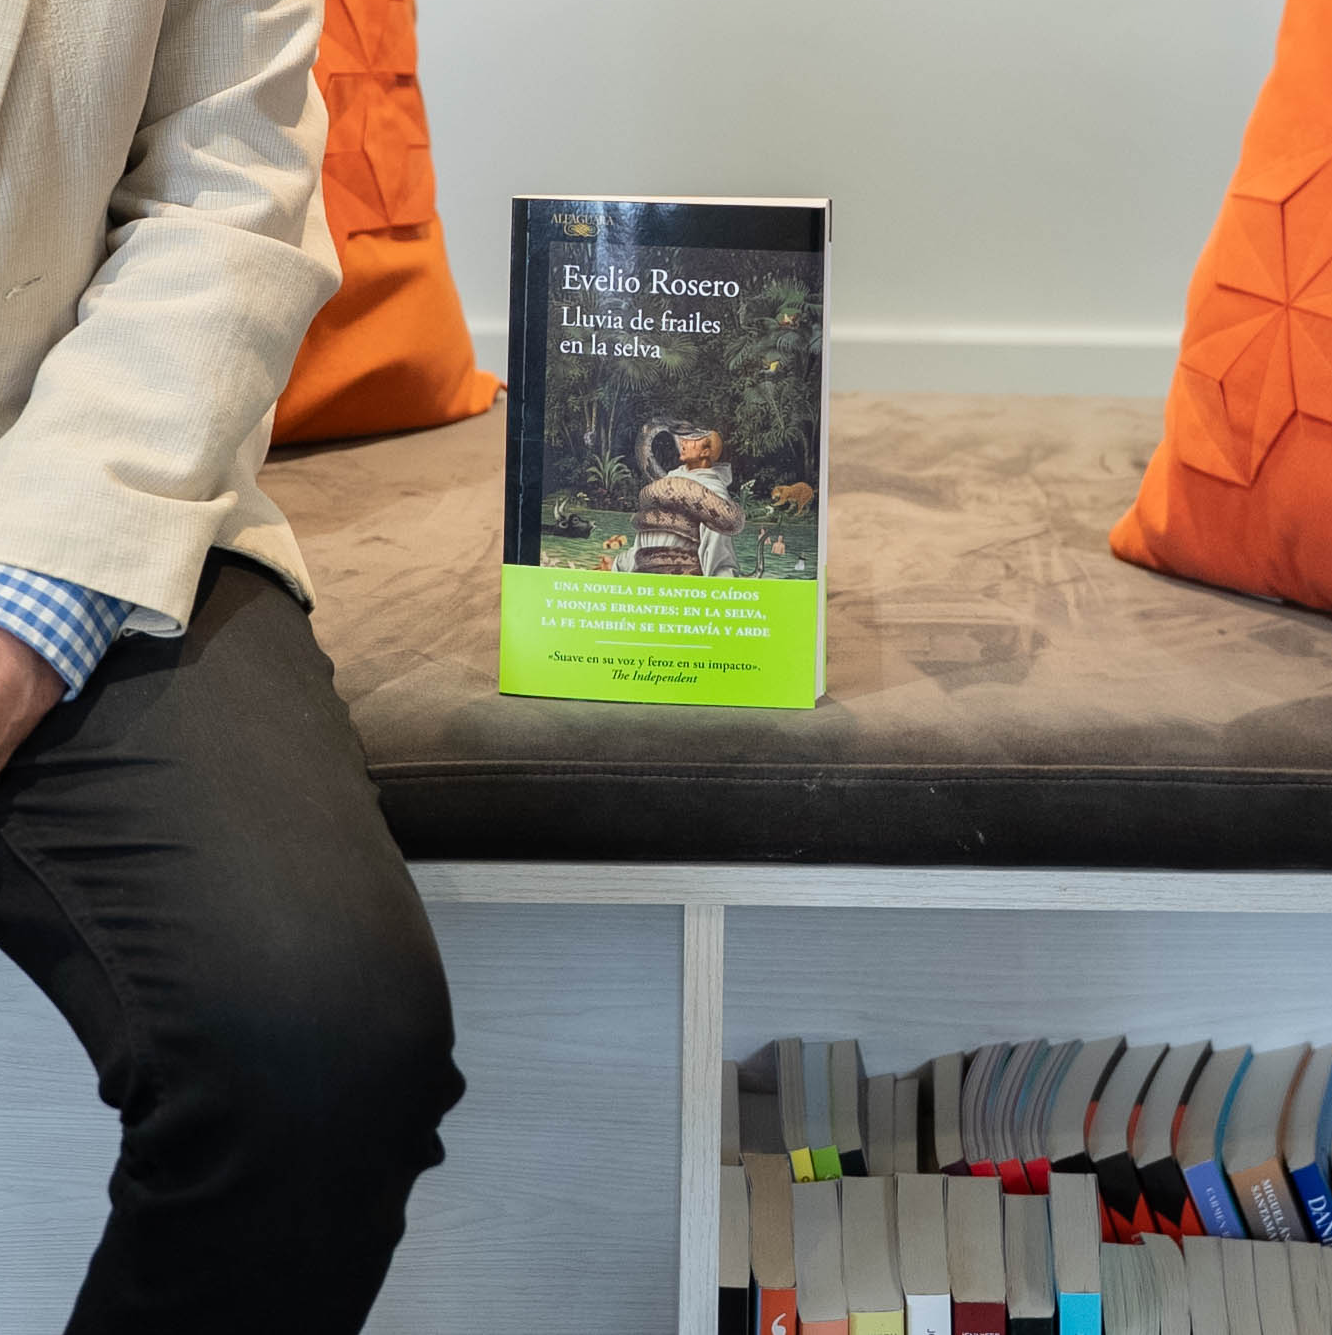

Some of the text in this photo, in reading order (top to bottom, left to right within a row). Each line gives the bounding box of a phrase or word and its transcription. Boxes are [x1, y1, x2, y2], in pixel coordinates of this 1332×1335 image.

[550, 213, 614, 225] ALFAGUARA
[562, 265, 740, 298] Evelio Rosero
[561, 307, 721, 334] Lluvia de frailes
[559, 334, 662, 359] en la selva
[554, 581, 760, 601] UNA NOVELA DE SANTOS CAÍDOS
[546, 599, 767, 620] Y MONJAS ERRANTES: EN LA SELVA,
[541, 616, 771, 638] LA FE TAMBIÉN SE EXTRAVÍA Y ARDE
[548, 650, 762, 672] «Suave en su voz feroz en su impacto».
[611, 669, 698, 686] The Independent
[1260, 1177, 1284, 1225] MIGUEL
